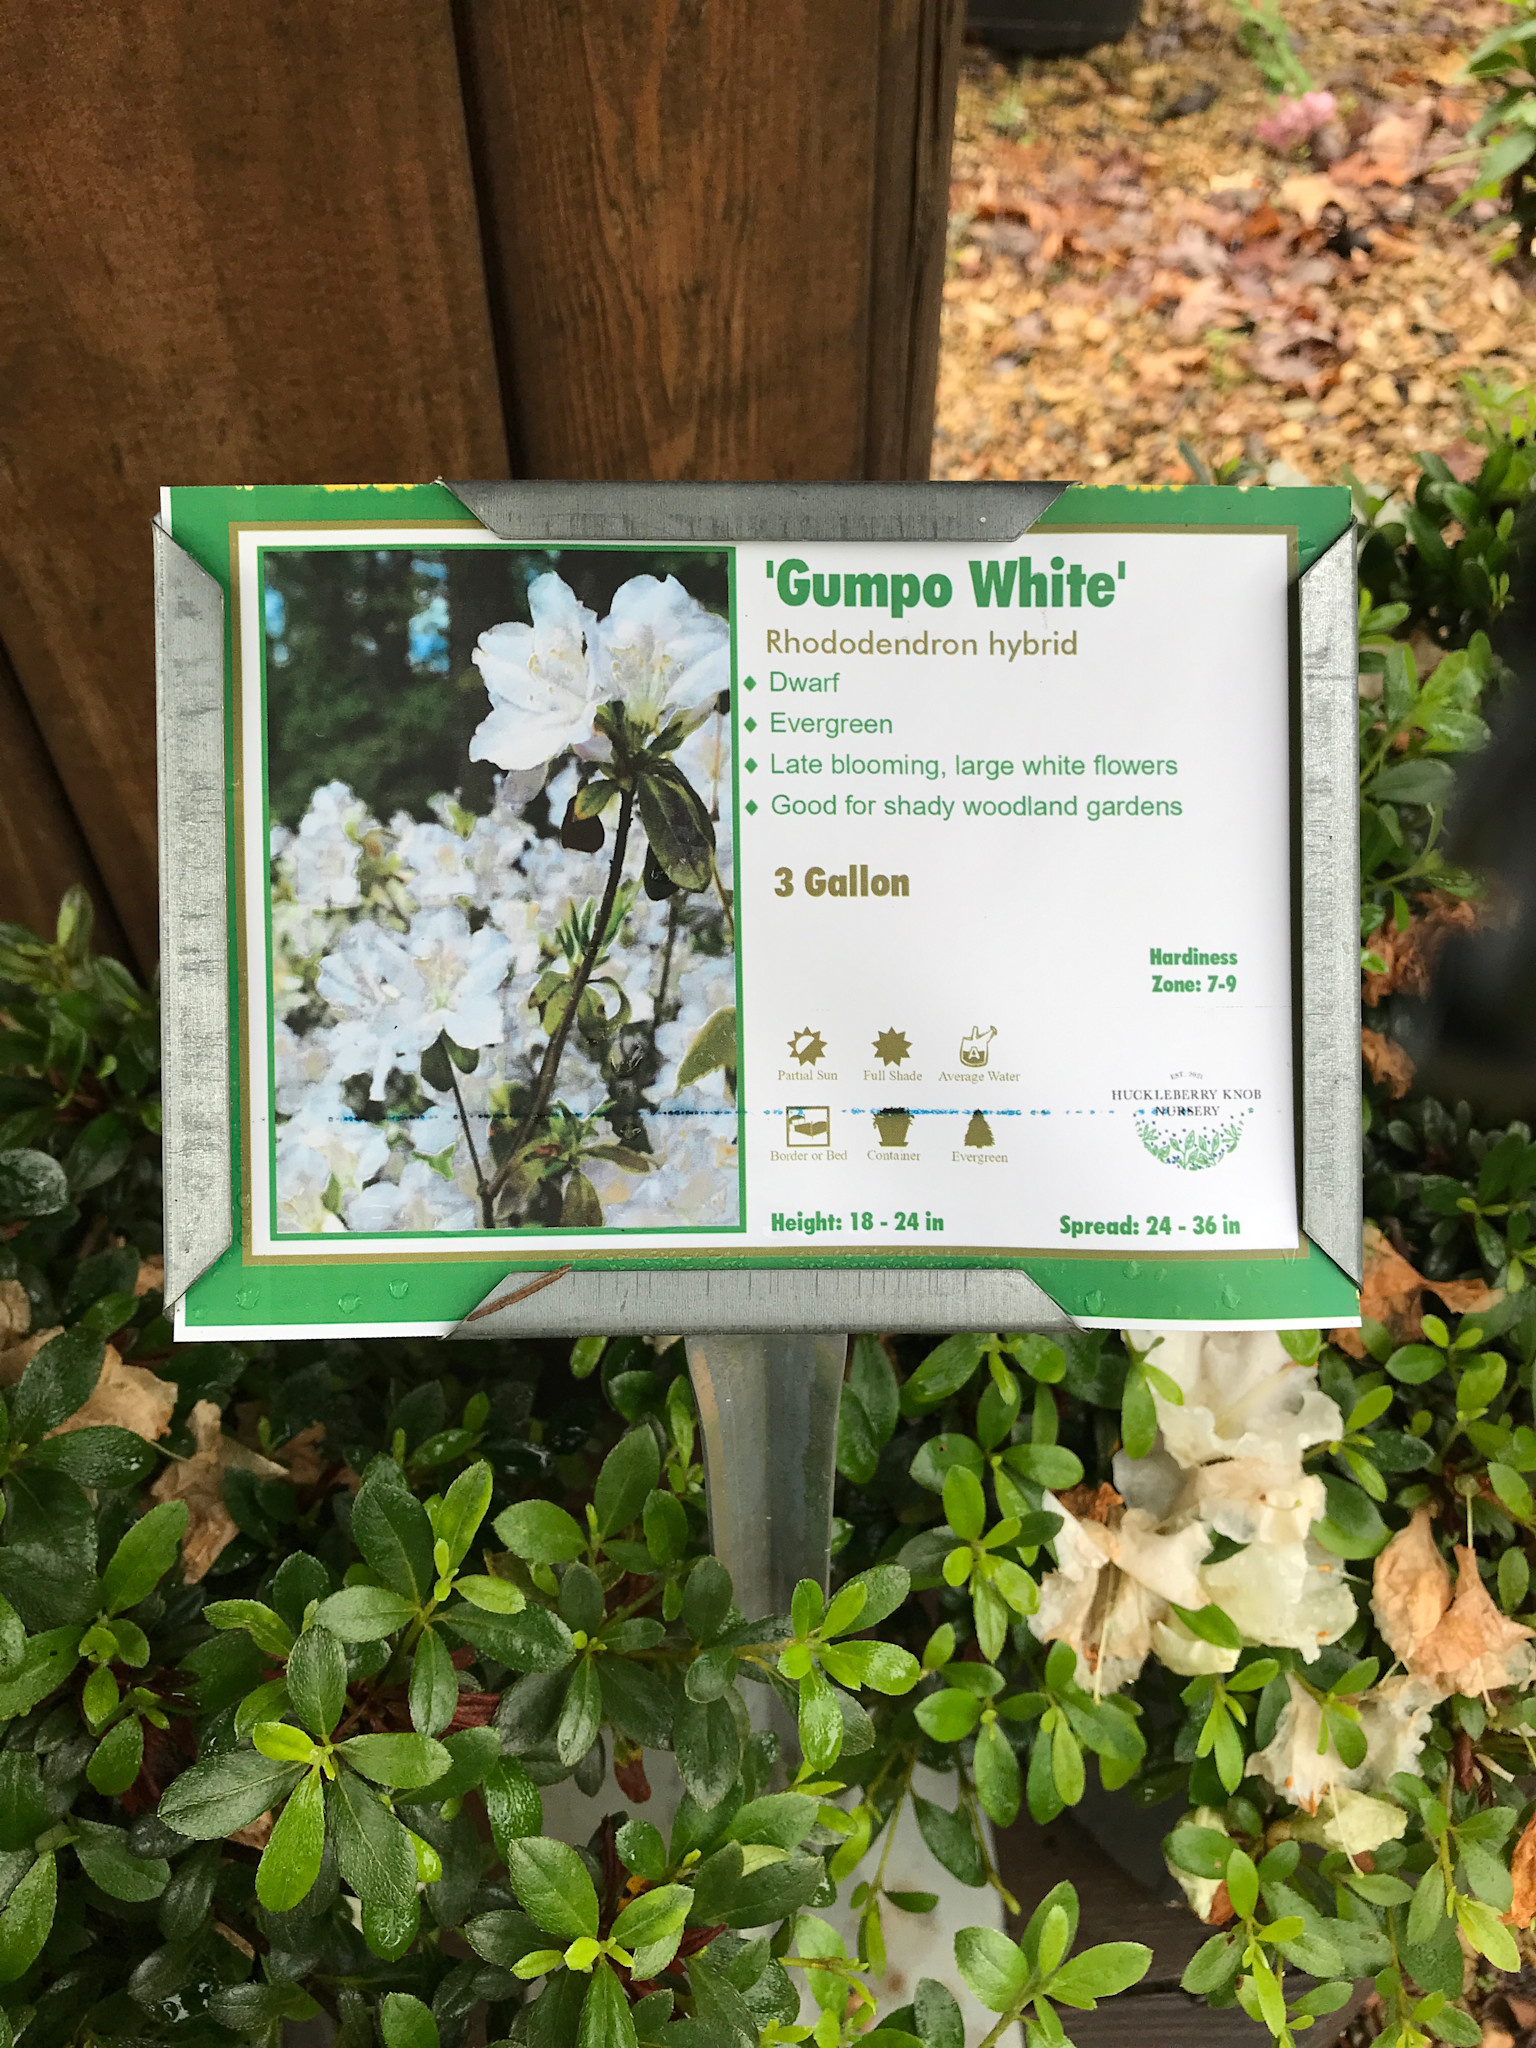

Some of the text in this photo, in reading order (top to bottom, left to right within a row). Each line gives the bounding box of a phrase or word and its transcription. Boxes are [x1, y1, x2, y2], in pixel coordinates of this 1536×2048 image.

[766, 556, 1126, 619] 'Gumpo White'
[766, 629, 1078, 663] Rhododendron hybrid
[769, 670, 841, 694] Dwarf
[770, 711, 893, 739] Evergreen
[770, 753, 1179, 782] Late blooming, large white flowers
[771, 793, 1184, 822] Good for shady woodland gardens
[774, 864, 910, 898] 3 Gallon
[1150, 947, 1238, 967] Hardiness
[1151, 974, 1238, 994] Zone: 7-9
[777, 1069, 838, 1082] Partial Sun
[863, 1069, 923, 1082] Full Shade
[938, 1070, 1021, 1085] Average Water
[1111, 1088, 1262, 1101] HUCKLEBERRY KNOB
[1153, 1105, 1220, 1117] NURSERY
[770, 1149, 848, 1162] Border or Bed
[866, 1149, 921, 1162] Container
[951, 1151, 1009, 1164] Evergreen
[771, 1211, 843, 1236] Height:
[851, 1211, 875, 1232] 18
[893, 1211, 920, 1232] 24
[924, 1211, 945, 1232] in
[1060, 1214, 1140, 1240] Spread:
[1146, 1215, 1173, 1237] 24
[1192, 1215, 1218, 1236] 36
[1221, 1214, 1241, 1235] in
